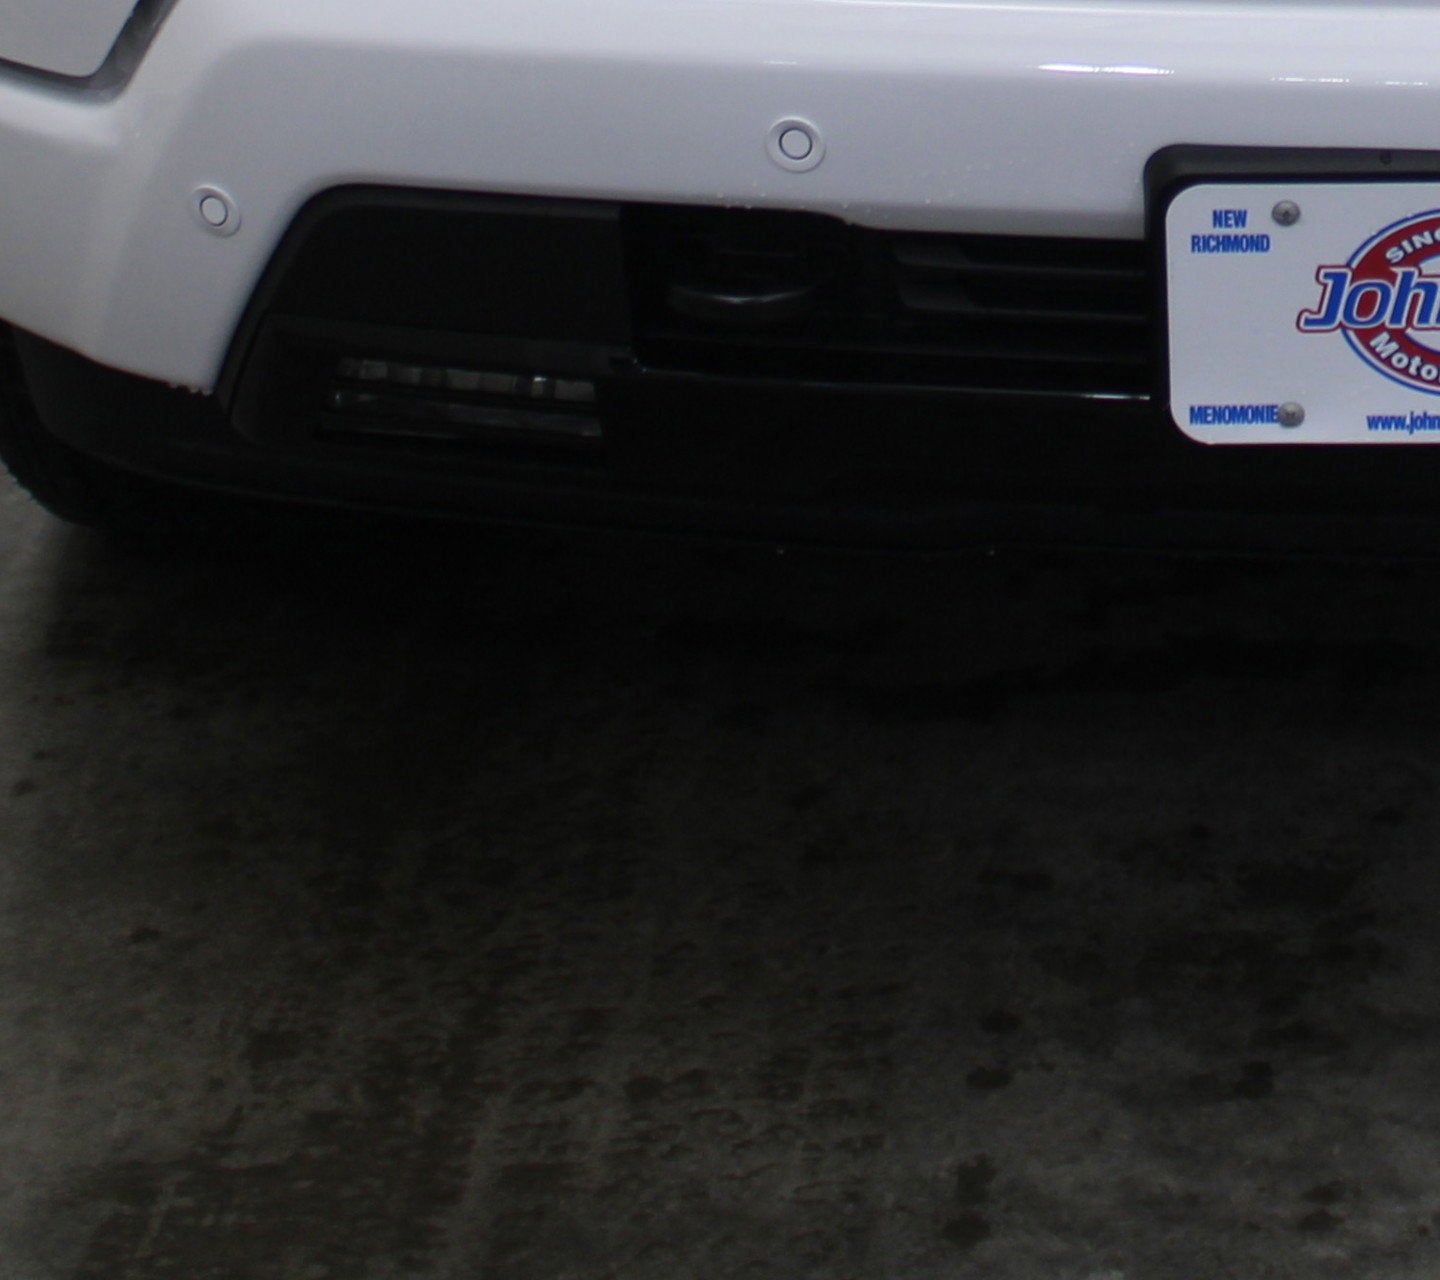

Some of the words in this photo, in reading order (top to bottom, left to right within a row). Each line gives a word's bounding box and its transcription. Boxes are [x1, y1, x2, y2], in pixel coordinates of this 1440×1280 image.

[1212, 209, 1247, 228] NEW
[1191, 234, 1271, 253] RICHMOND
[1189, 404, 1280, 425] MENOMONIE
